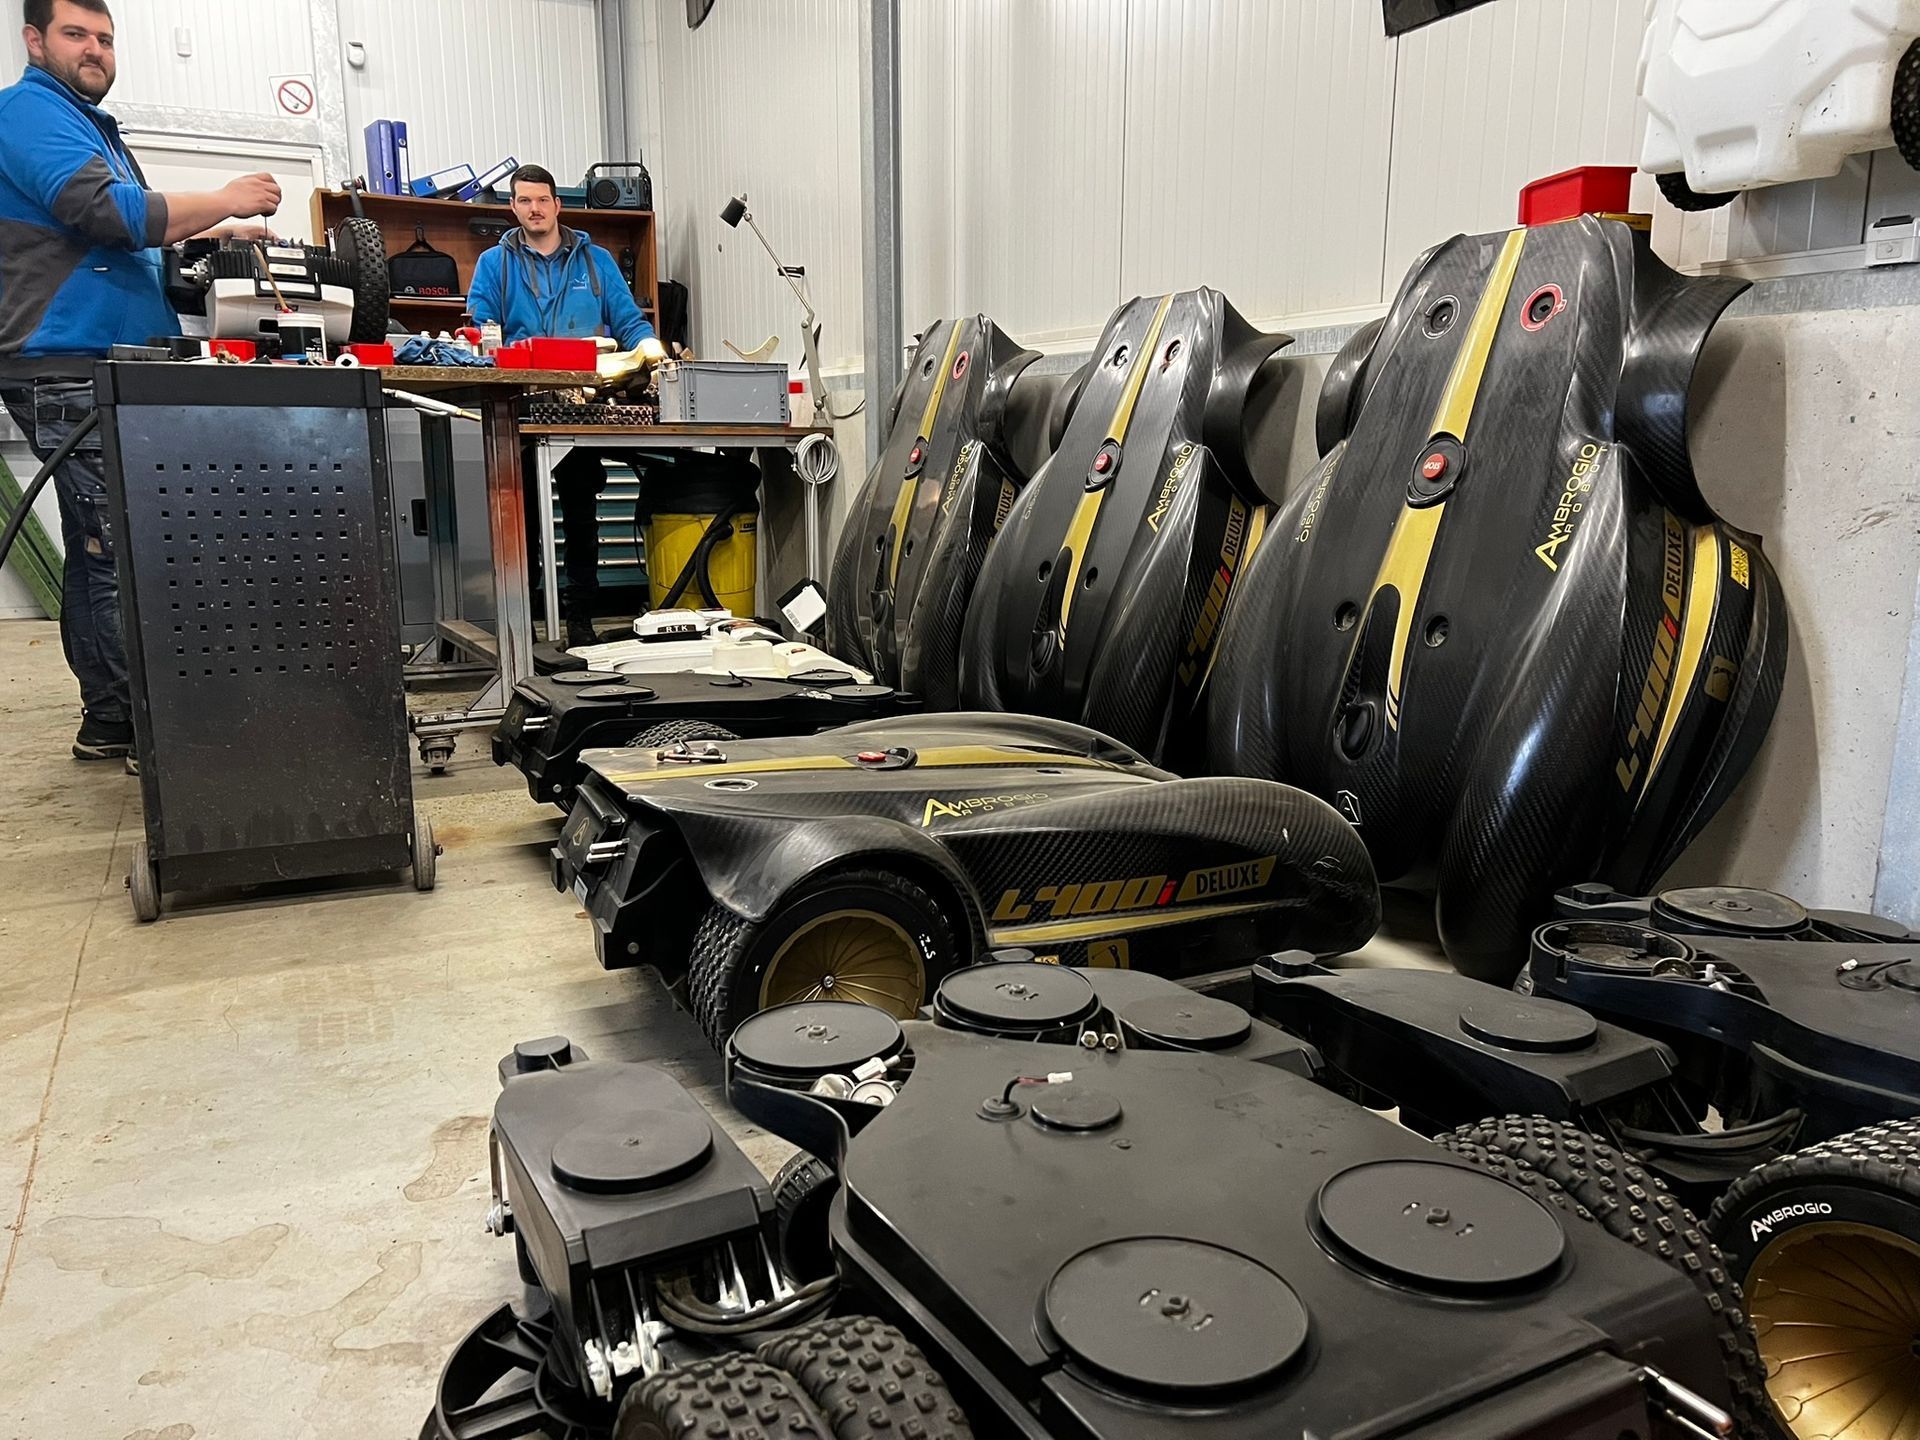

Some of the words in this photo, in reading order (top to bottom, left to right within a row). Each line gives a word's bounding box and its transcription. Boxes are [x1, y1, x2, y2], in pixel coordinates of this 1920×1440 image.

[1147, 445, 1192, 533] AMBROGIO
[1535, 443, 1598, 572] AMBROGIO
[1564, 445, 1608, 533] ROBOT
[1224, 508, 1244, 557] DELUXE
[1665, 527, 1682, 599] DELUXE
[665, 625, 689, 633] RTK
[921, 793, 1049, 828] AMBROGIO
[1196, 864, 1260, 896] DELUXE
[1750, 1202, 1832, 1242] AMBROGIO
